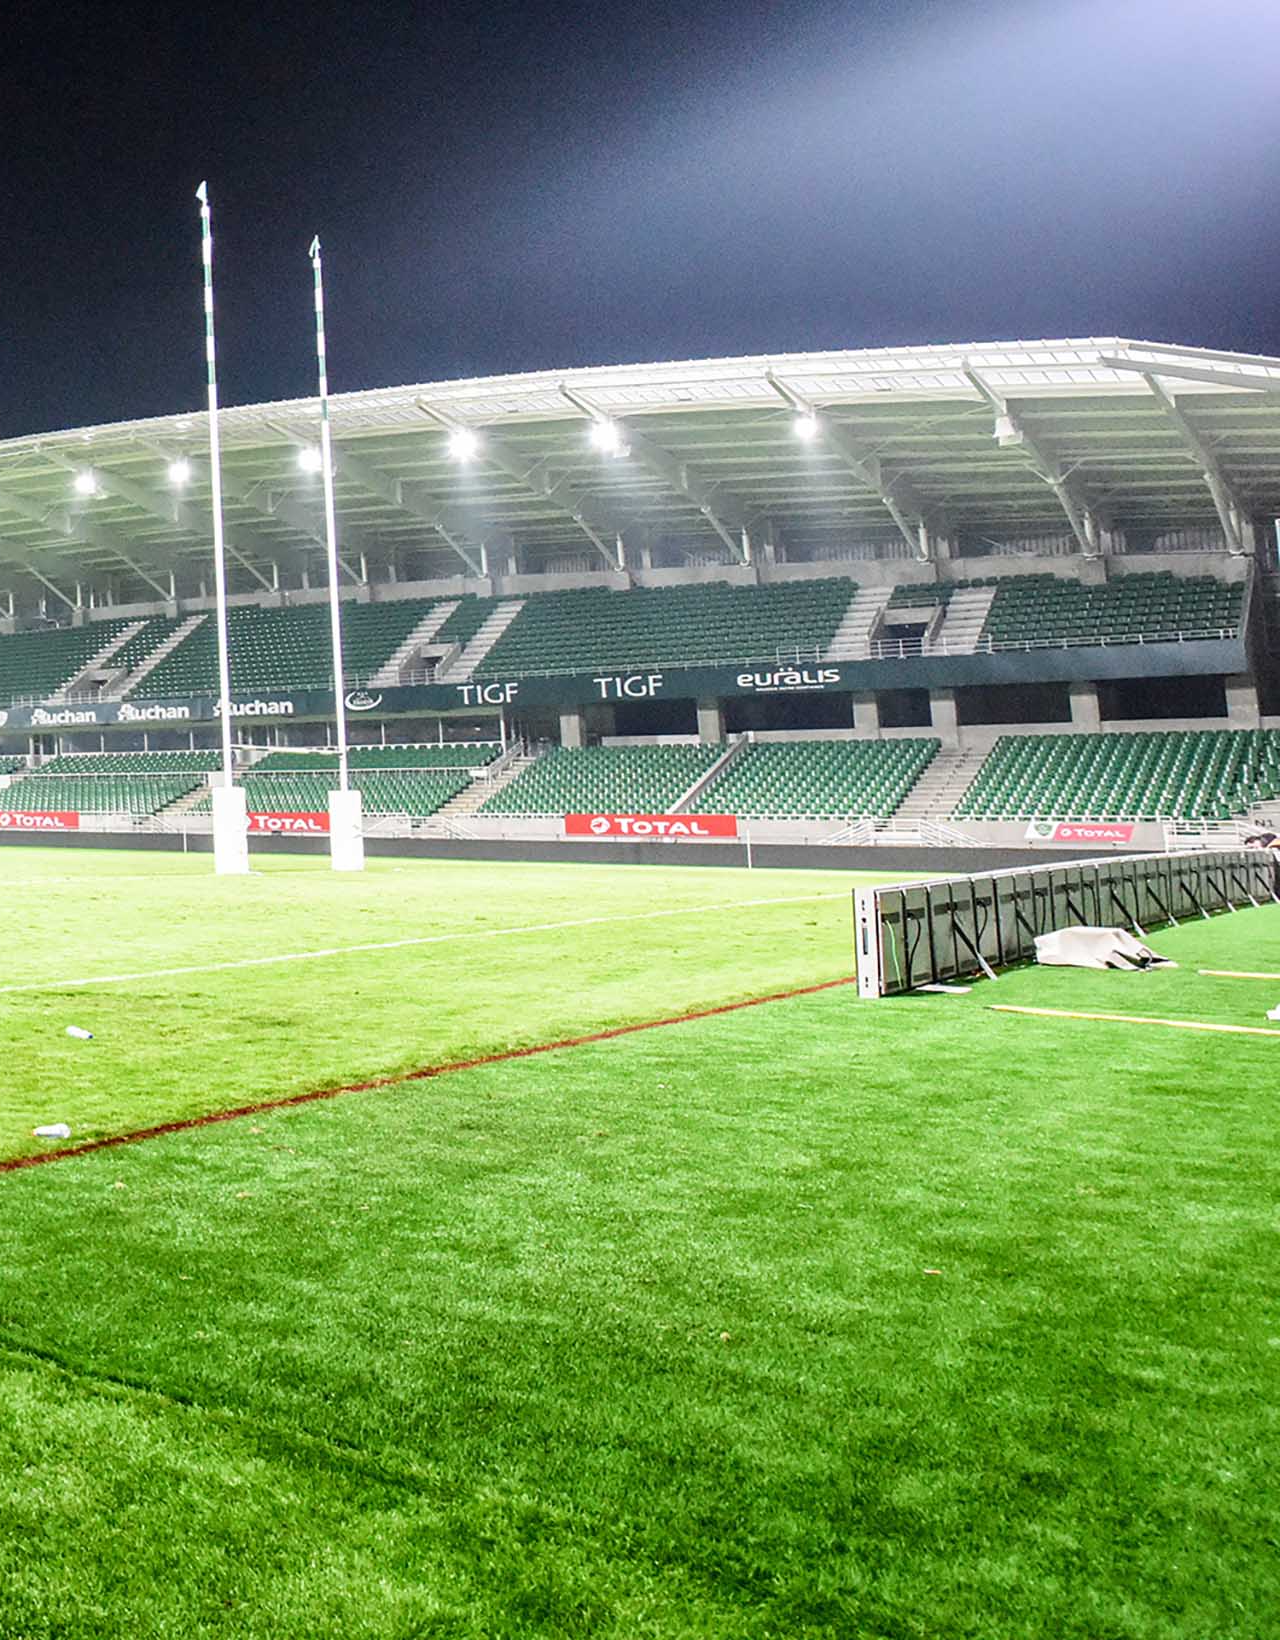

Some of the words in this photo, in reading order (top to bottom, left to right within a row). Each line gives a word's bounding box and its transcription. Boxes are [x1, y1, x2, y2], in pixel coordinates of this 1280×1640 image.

[457, 683, 518, 705] TIGF
[593, 675, 663, 698] TIGF
[31, 709, 96, 725] Auchan
[118, 704, 189, 721] Auchan
[15, 814, 64, 826] TOTAL
[254, 815, 322, 830] TOTAL
[614, 818, 709, 834] TOTAL
[1073, 828, 1126, 838] TOTAL
